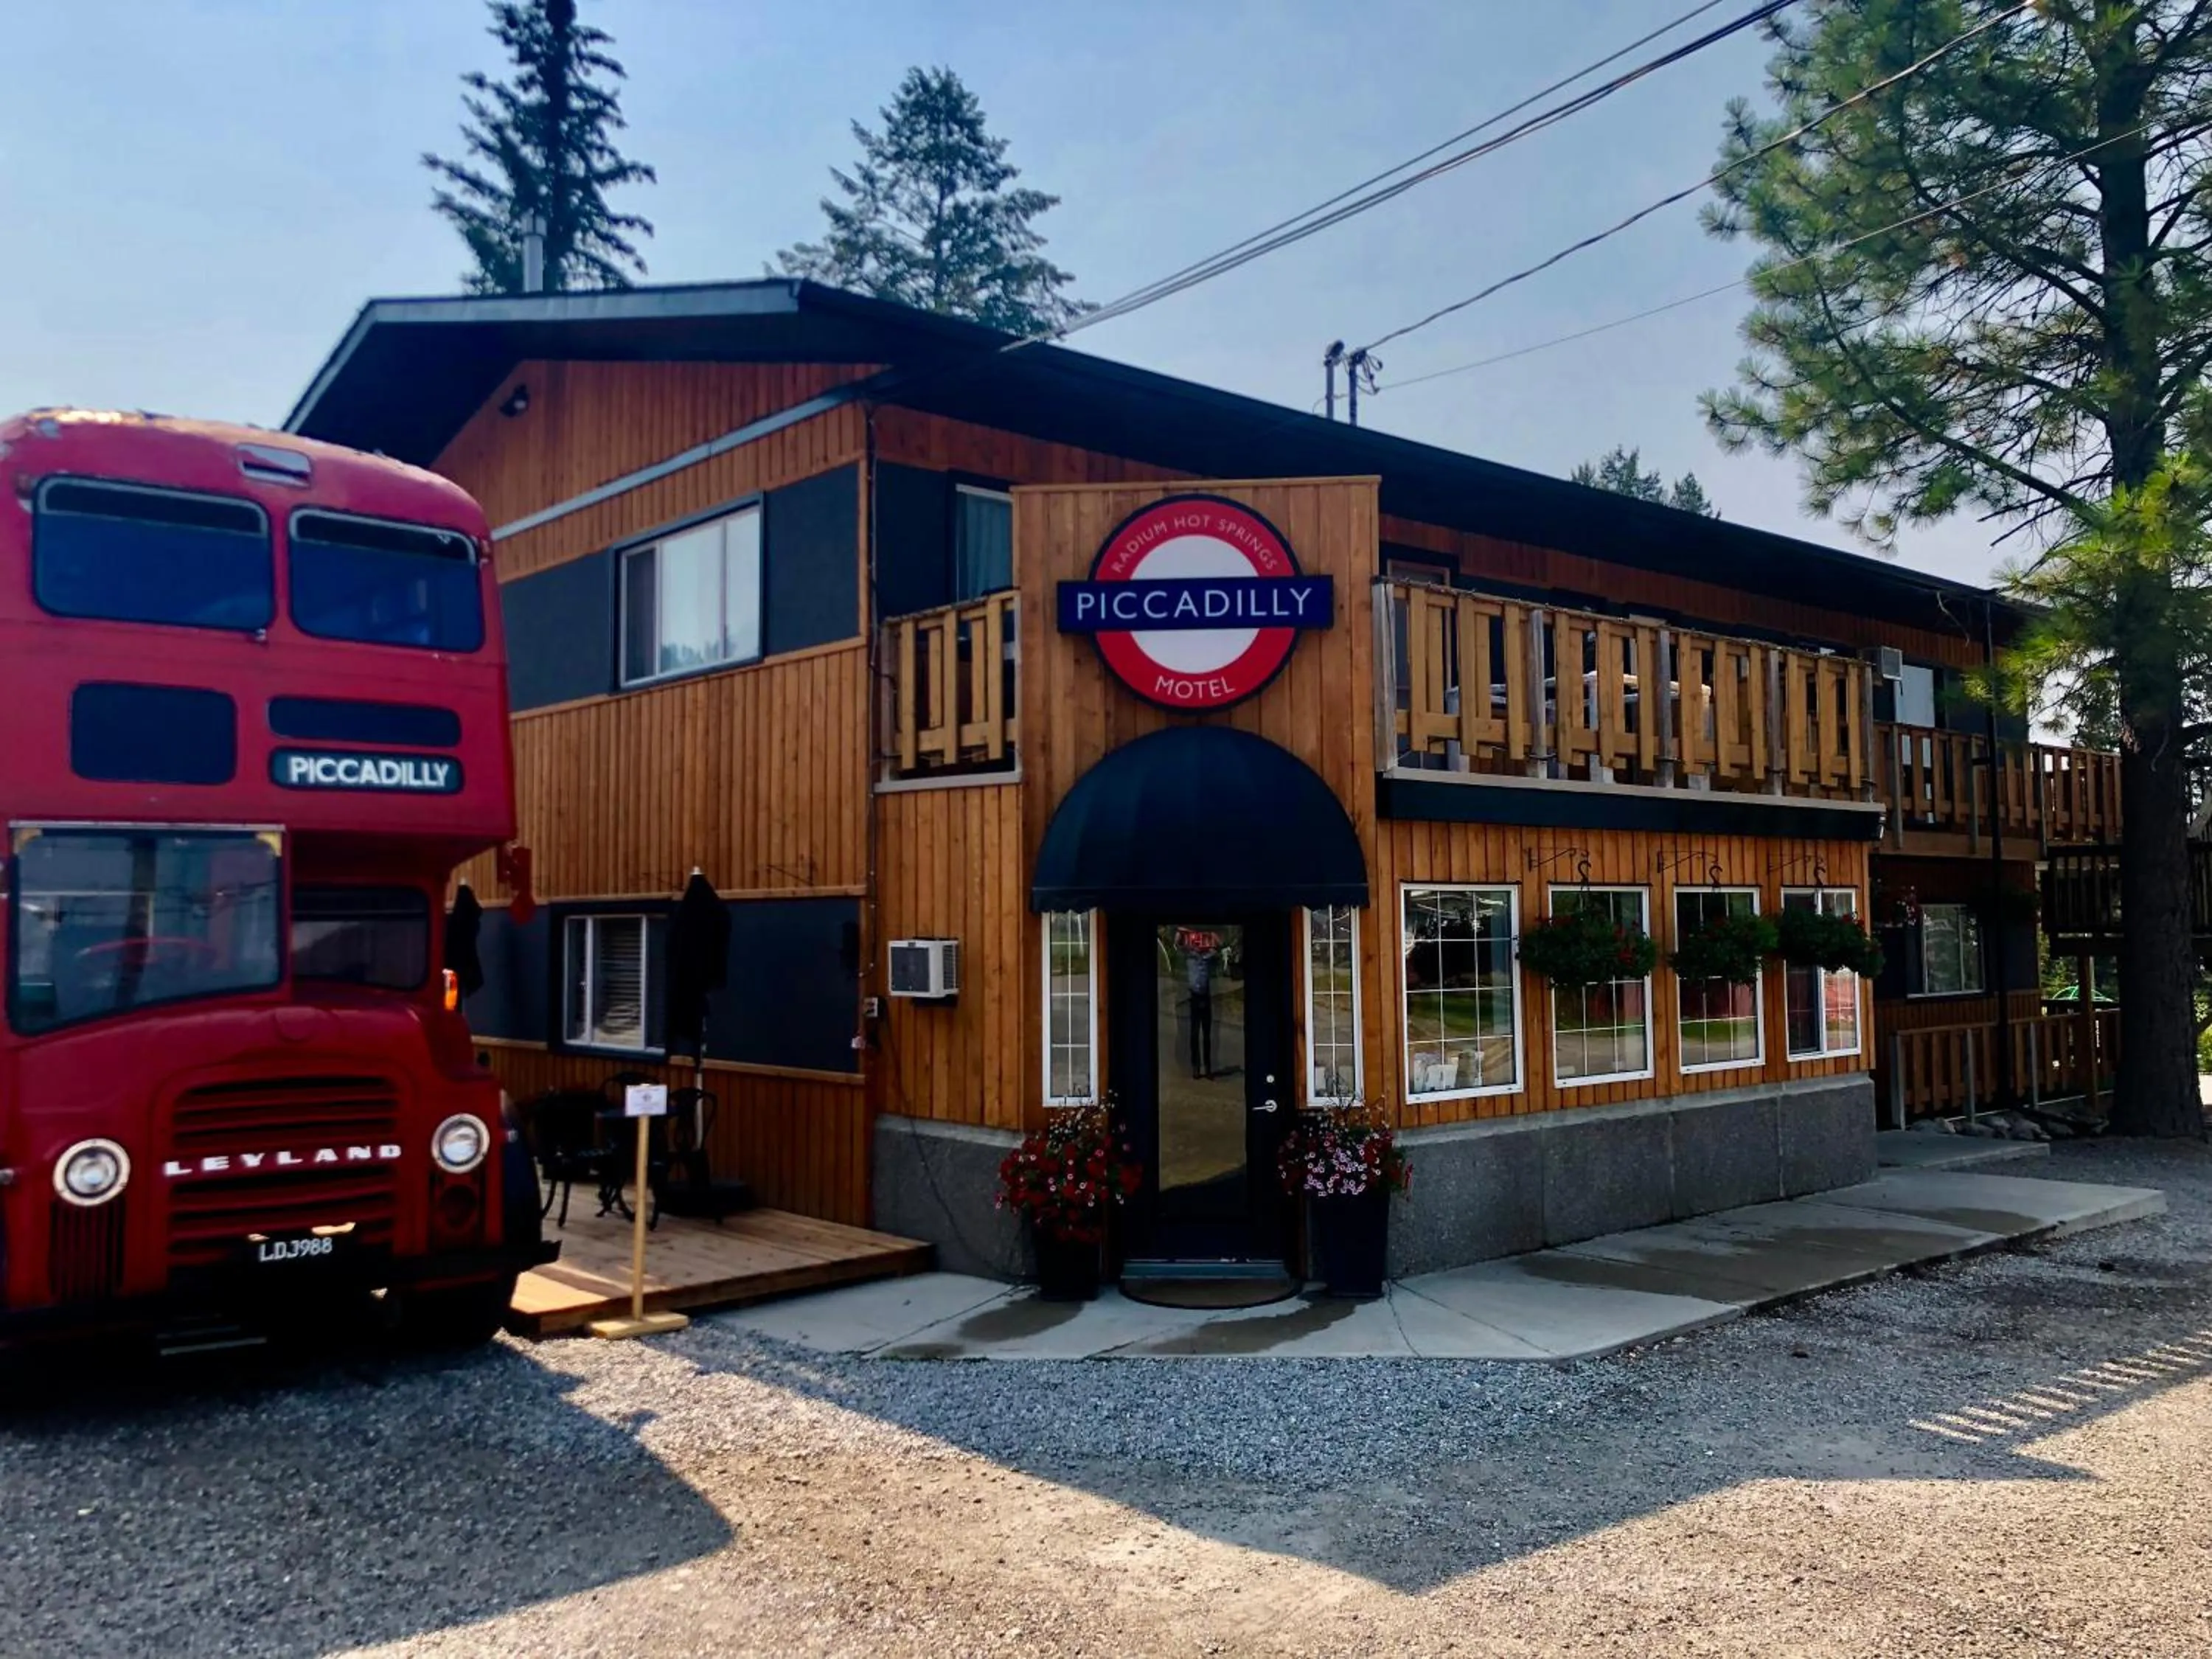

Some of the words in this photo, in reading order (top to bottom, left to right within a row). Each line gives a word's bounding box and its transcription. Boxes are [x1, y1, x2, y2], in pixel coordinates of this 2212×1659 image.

[1110, 521, 1167, 573] RADIUM
[1175, 515, 1210, 529] HOT
[1219, 518, 1277, 570] SPRINGS
[1077, 588, 1312, 620] PICCADILLY
[1155, 676, 1235, 698] MOTEL
[289, 757, 449, 787] PICCADILLY
[164, 1144, 401, 1176] LEYLAND
[259, 1237, 333, 1262] LDJ988
